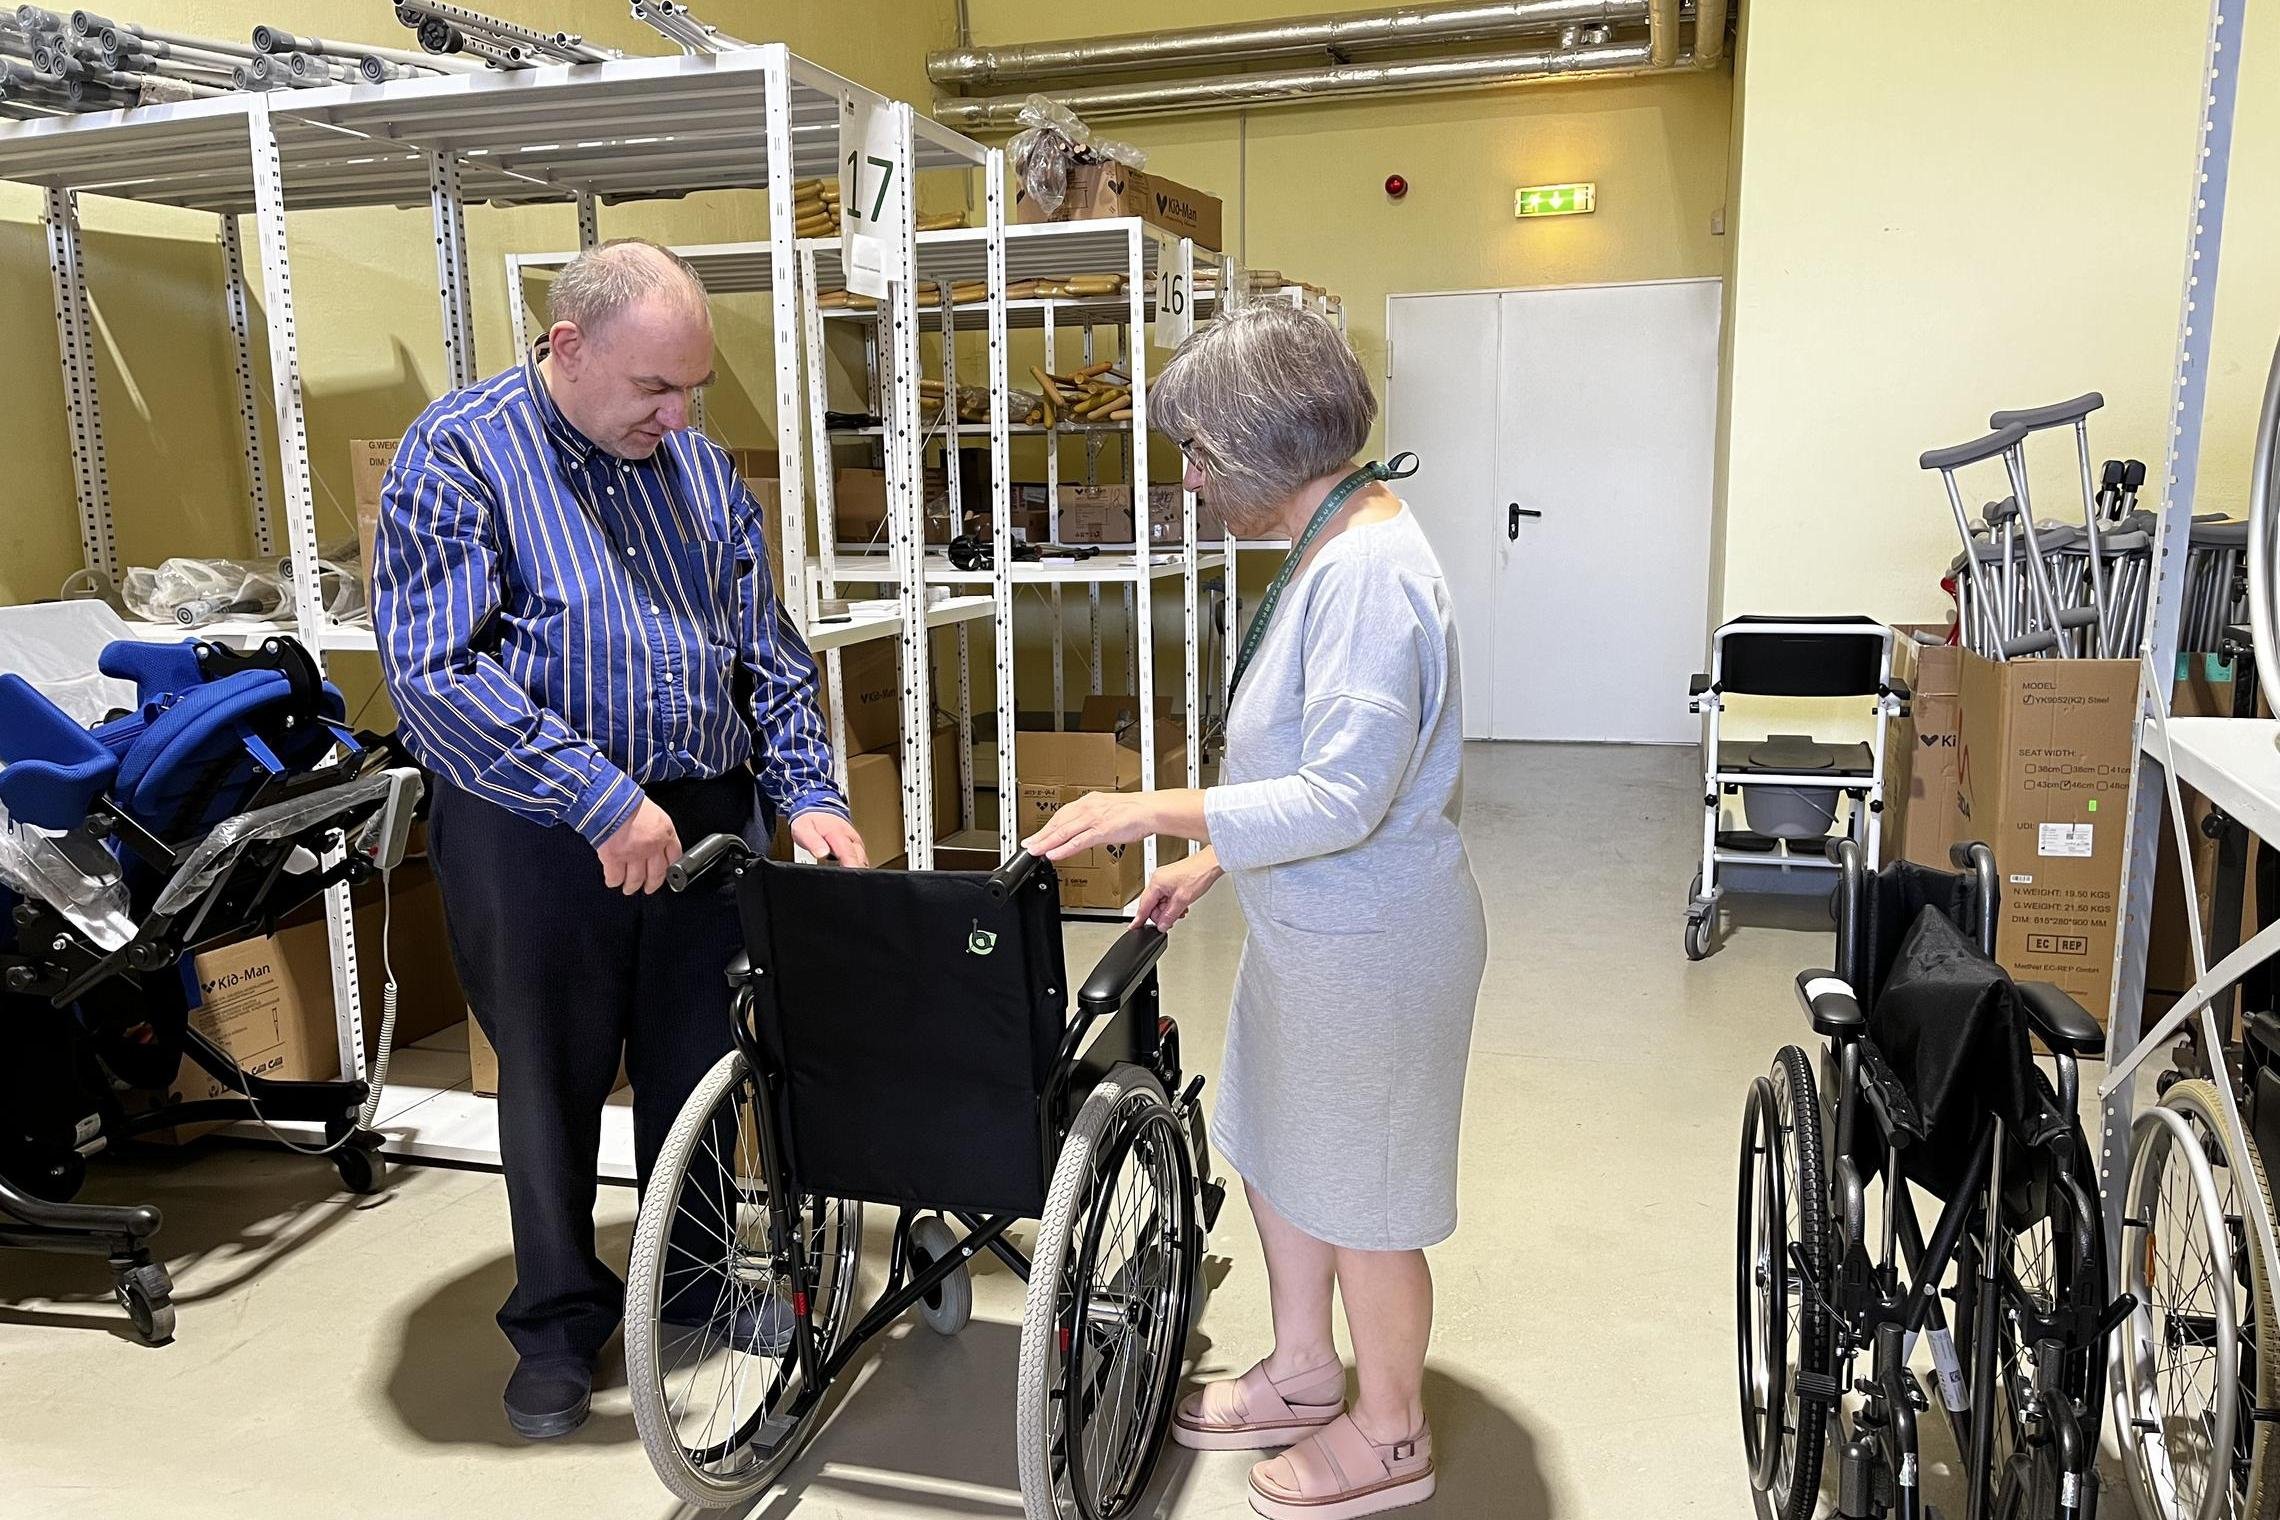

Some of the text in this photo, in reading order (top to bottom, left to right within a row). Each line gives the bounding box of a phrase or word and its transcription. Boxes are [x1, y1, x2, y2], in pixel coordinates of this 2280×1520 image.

[847, 150, 894, 222] 17
[1161, 271, 1184, 315] 16
[368, 441, 398, 450] G.WEIG
[2019, 749, 2042, 757] SEAT
[2090, 890, 2111, 899] KGS
[2090, 905, 2112, 913] KGS
[2090, 919, 2107, 927] MM
[2036, 938, 2082, 951] EC REP
[217, 964, 271, 991] Kid-Man
